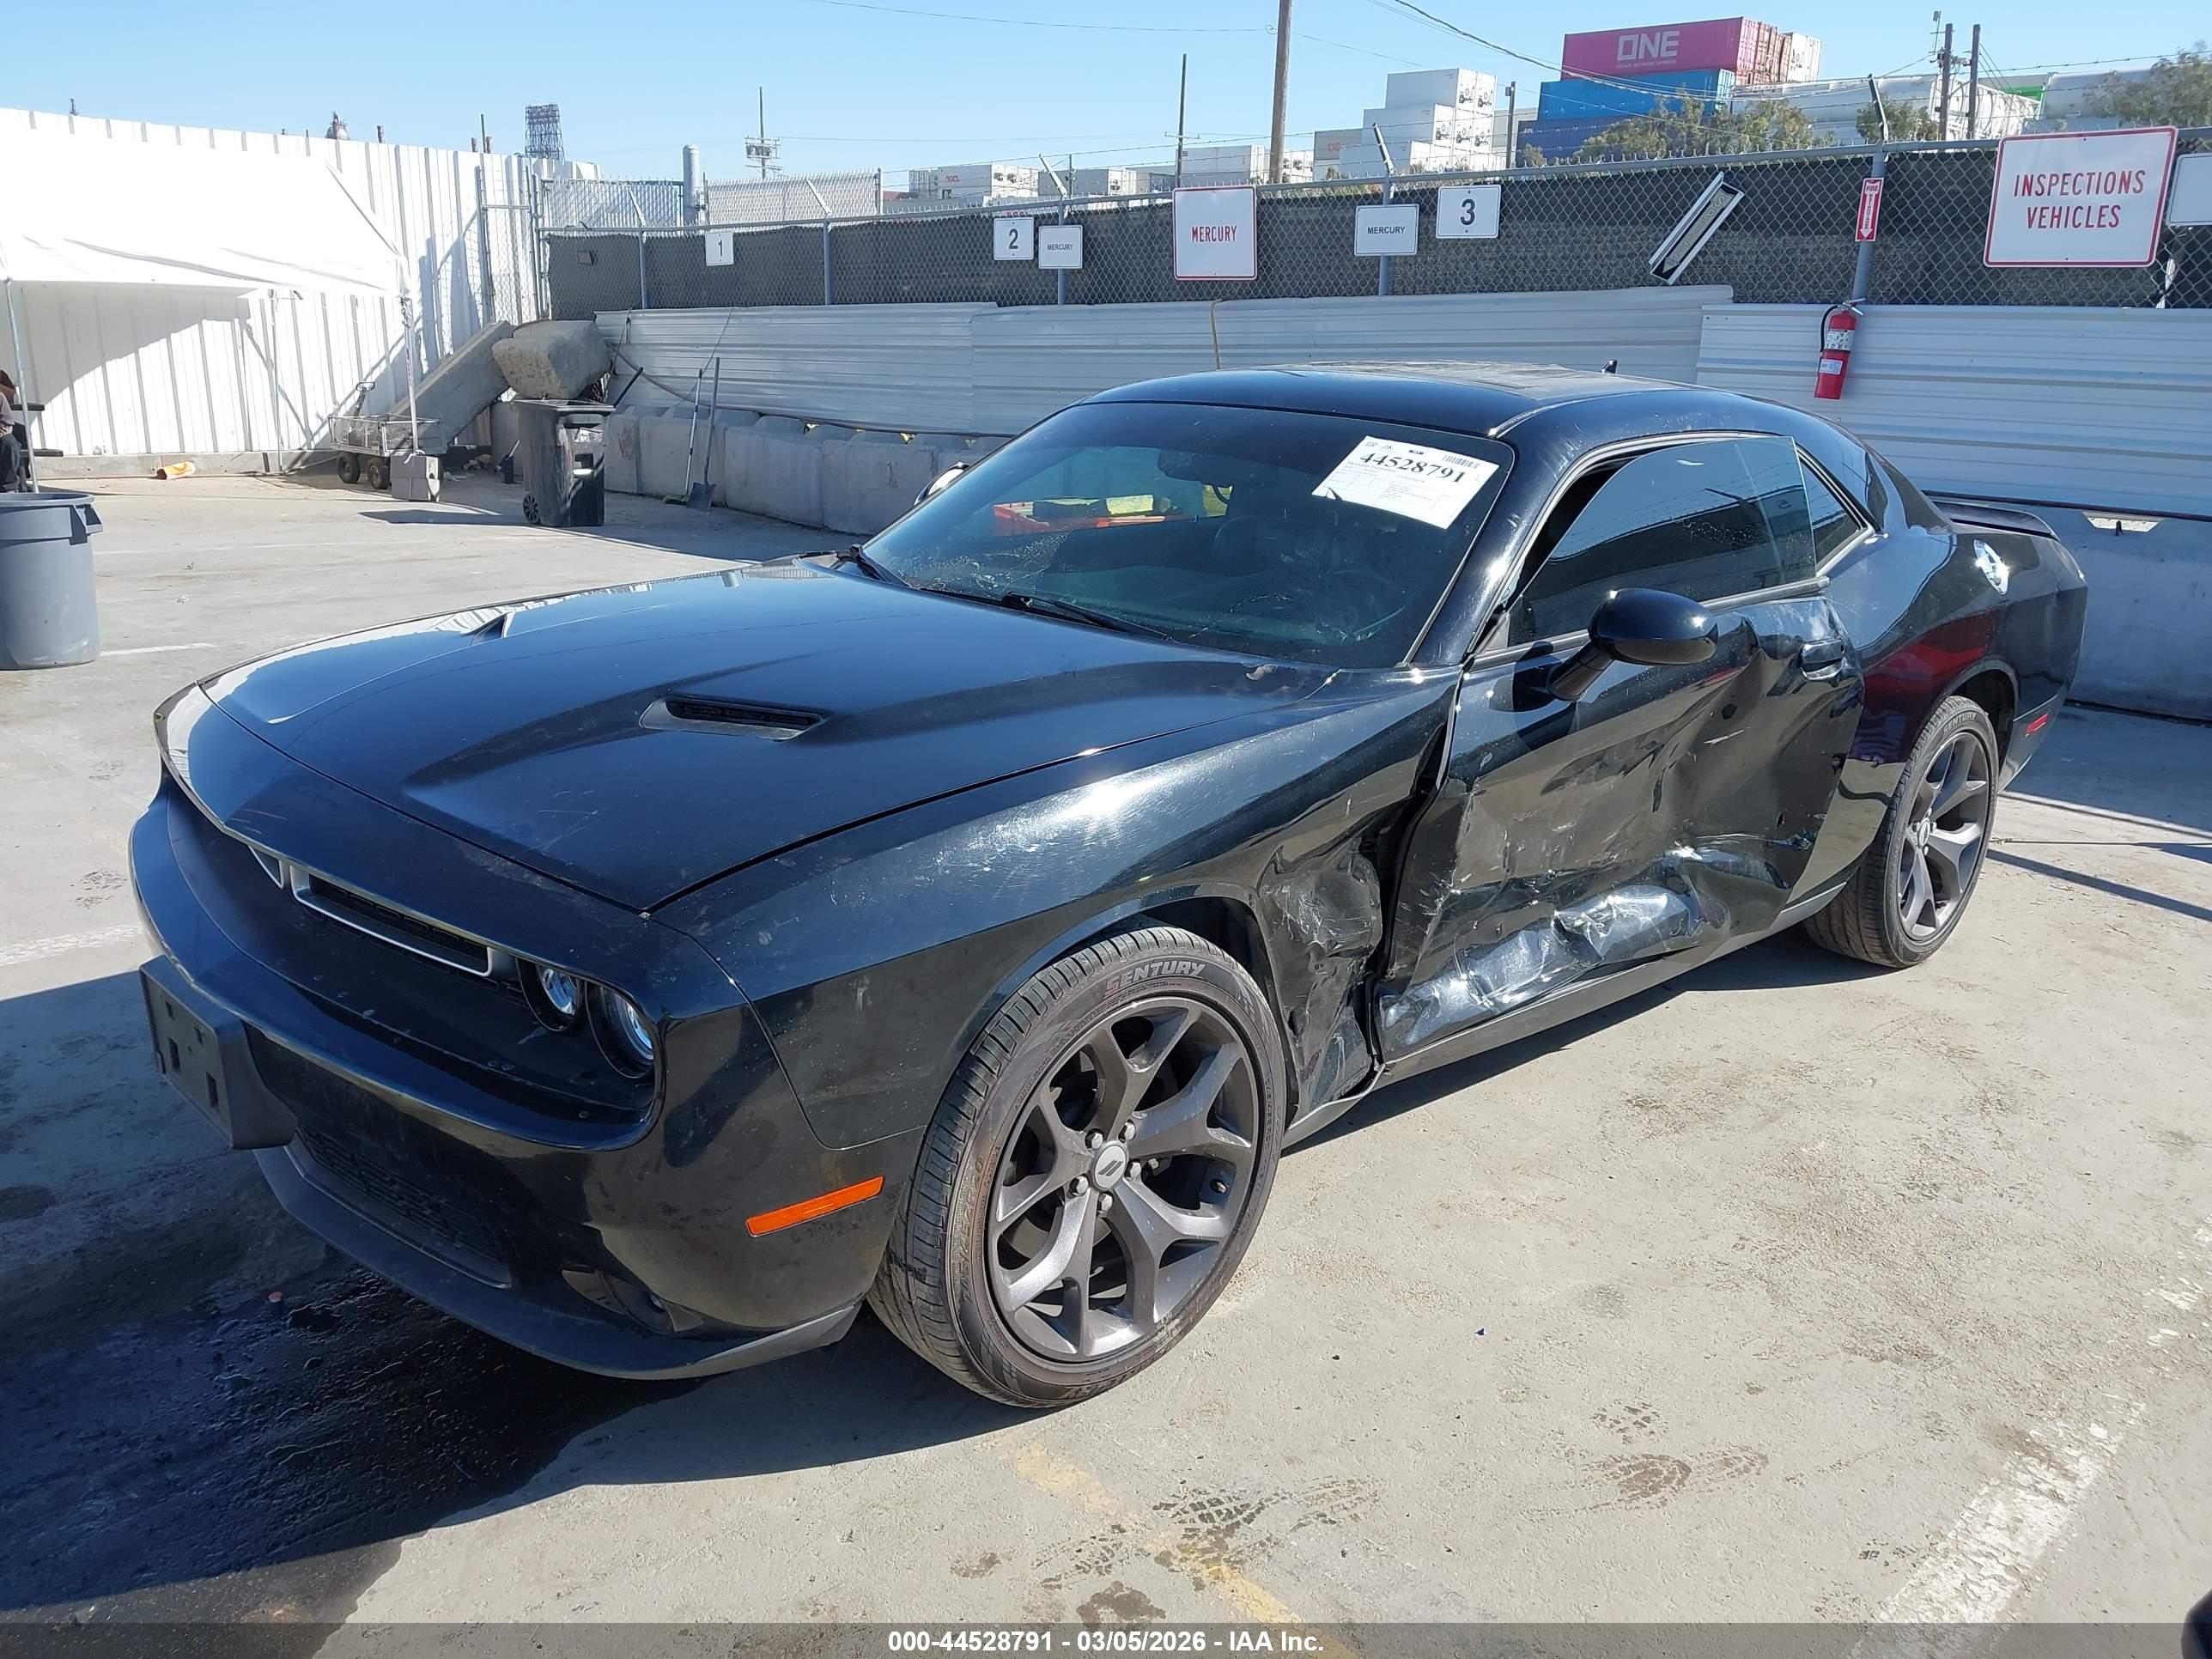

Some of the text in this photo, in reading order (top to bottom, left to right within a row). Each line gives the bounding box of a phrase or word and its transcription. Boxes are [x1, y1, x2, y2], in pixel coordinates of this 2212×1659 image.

[1617, 31, 1680, 61] ONE
[2014, 170, 2146, 197] INSPECTIONS
[1460, 198, 1476, 226] 3
[2027, 204, 2122, 229] VEHICLES
[1008, 228, 1019, 250] 2
[1192, 225, 1237, 242] MERCURY
[1367, 226, 1406, 234] MERCURY
[717, 240, 723, 257] 1
[1359, 453, 1467, 483] 44528791
[1104, 960, 1206, 996] SENTURY
